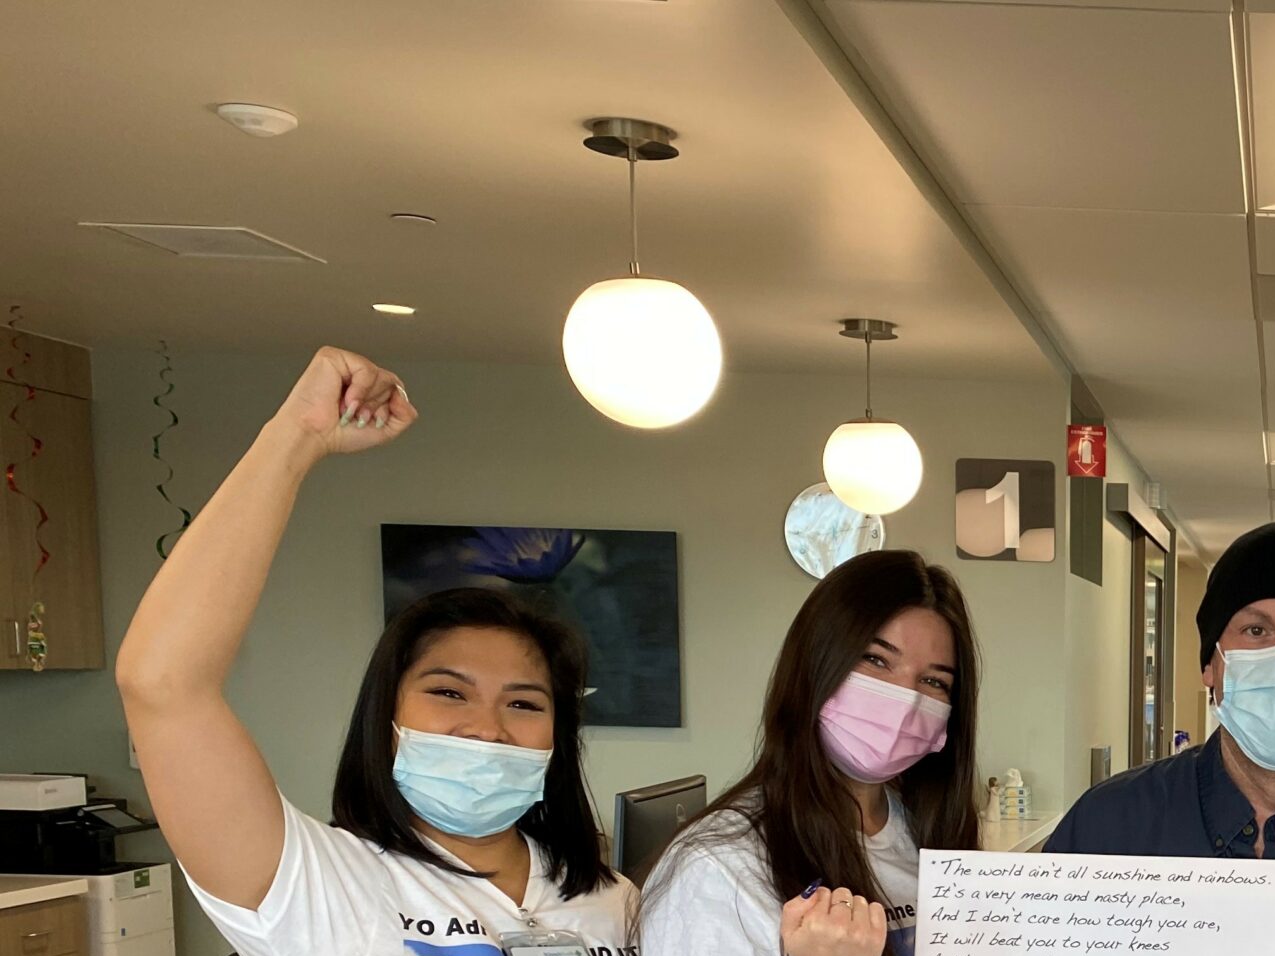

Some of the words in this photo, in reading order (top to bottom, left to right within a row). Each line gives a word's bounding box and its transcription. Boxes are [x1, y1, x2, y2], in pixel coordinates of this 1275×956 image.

[985, 472, 1020, 549] 1
[978, 864, 1024, 876] world
[1029, 862, 1062, 878] ain't
[1068, 866, 1088, 879] all
[1093, 868, 1161, 881] sunshine
[1168, 871, 1193, 882] and
[1198, 870, 1271, 884] rainbows.
[932, 882, 965, 898] It's
[971, 890, 980, 900] a
[985, 890, 1016, 904] very
[1021, 892, 1058, 901] mean
[1064, 890, 1090, 902] and
[1094, 891, 1136, 909] nasty
[1138, 891, 1185, 908] place,
[931, 907, 960, 921] And
[965, 910, 978, 922] I
[982, 907, 1022, 923] don't
[1028, 915, 1060, 924] care
[1066, 913, 1101, 926] how
[1107, 914, 1152, 933] tough
[1157, 920, 1187, 933] you
[1193, 921, 1220, 932] are,
[929, 932, 948, 944] It
[954, 933, 984, 945] will
[989, 932, 1022, 946] beat
[1026, 938, 1057, 952] you
[1062, 936, 1081, 948] to
[1085, 940, 1122, 954] your
[1128, 936, 1170, 952] knees
